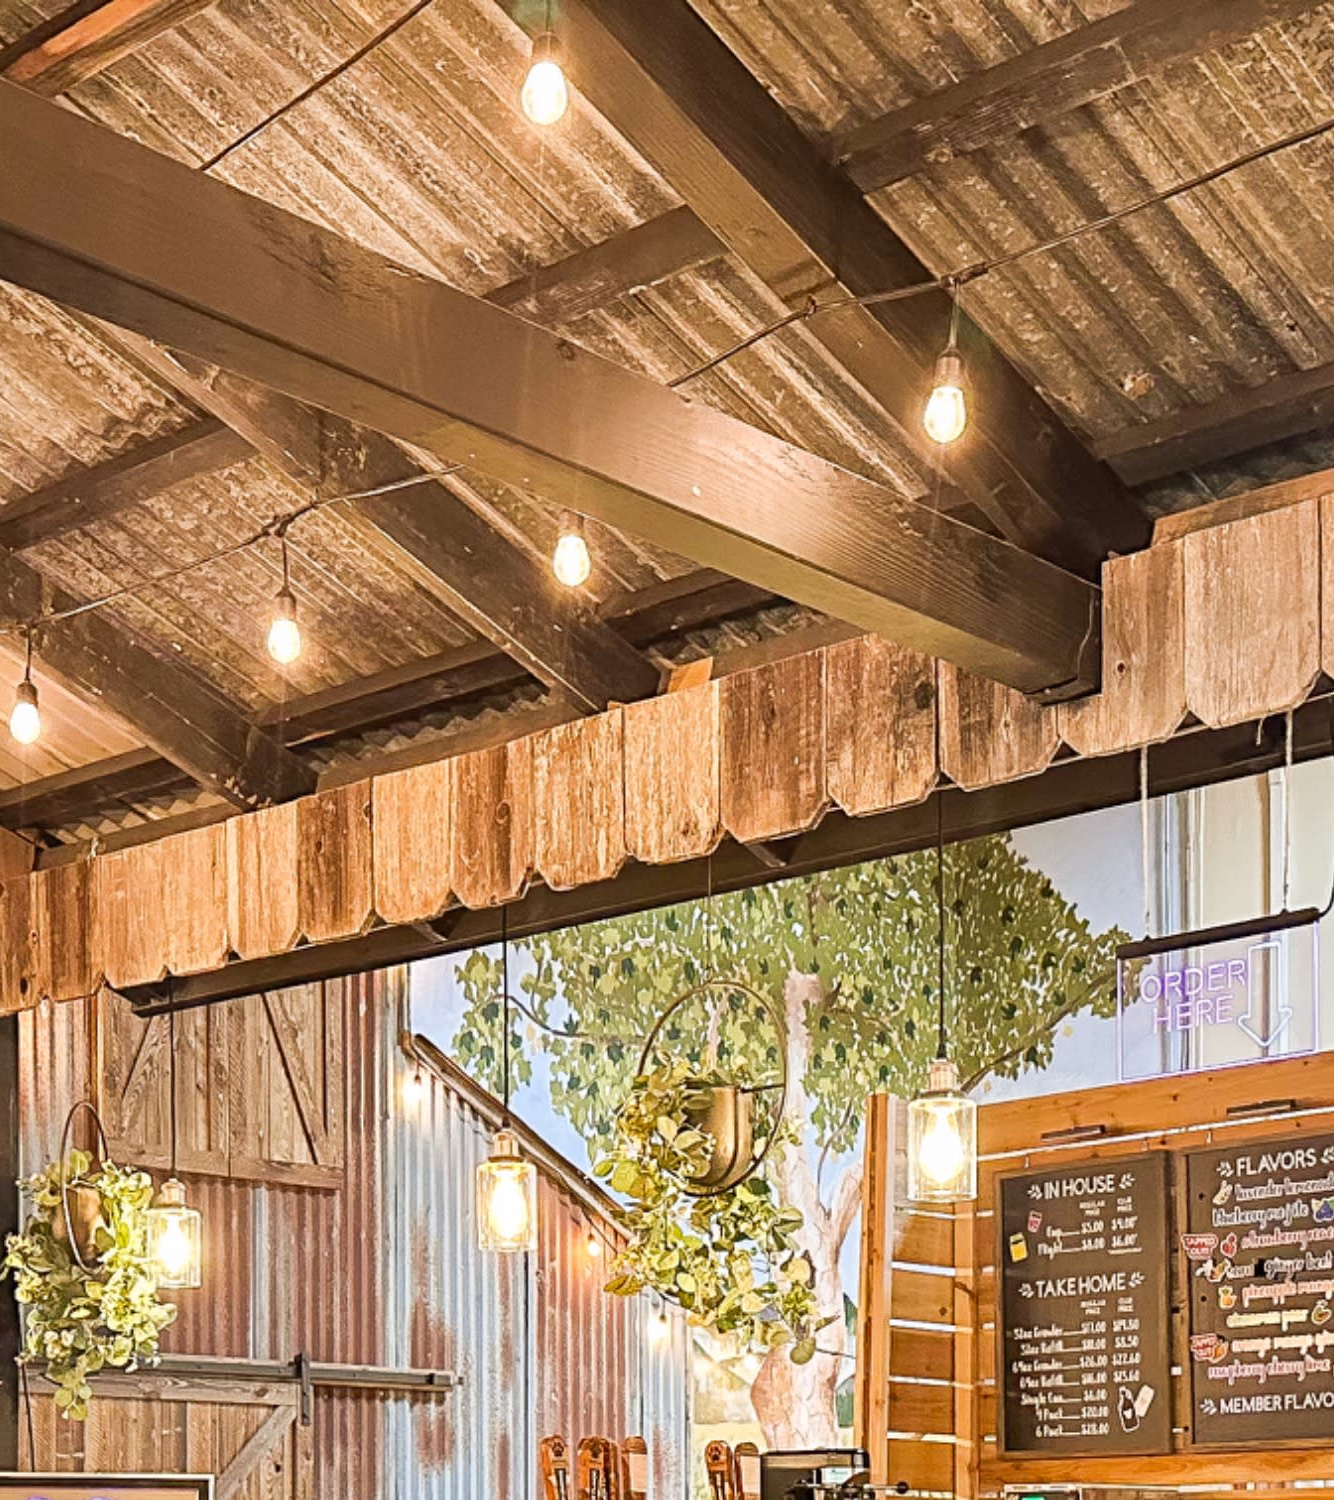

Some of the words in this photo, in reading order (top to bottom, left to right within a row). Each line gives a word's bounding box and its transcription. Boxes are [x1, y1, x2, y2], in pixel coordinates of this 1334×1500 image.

[1139, 959, 1247, 1003] ORDER
[1152, 996, 1234, 1034] HERE
[1236, 1148, 1317, 1177] FLAVORS
[1044, 1181, 1060, 1199] IN
[1062, 1174, 1115, 1196] HOUSE
[1081, 1221, 1105, 1234] $5.00
[1036, 1278, 1076, 1298] TAKE
[1078, 1273, 1126, 1294] HOME
[1220, 1395, 1282, 1414] MEMBER
[1035, 1425, 1043, 1437] 6
